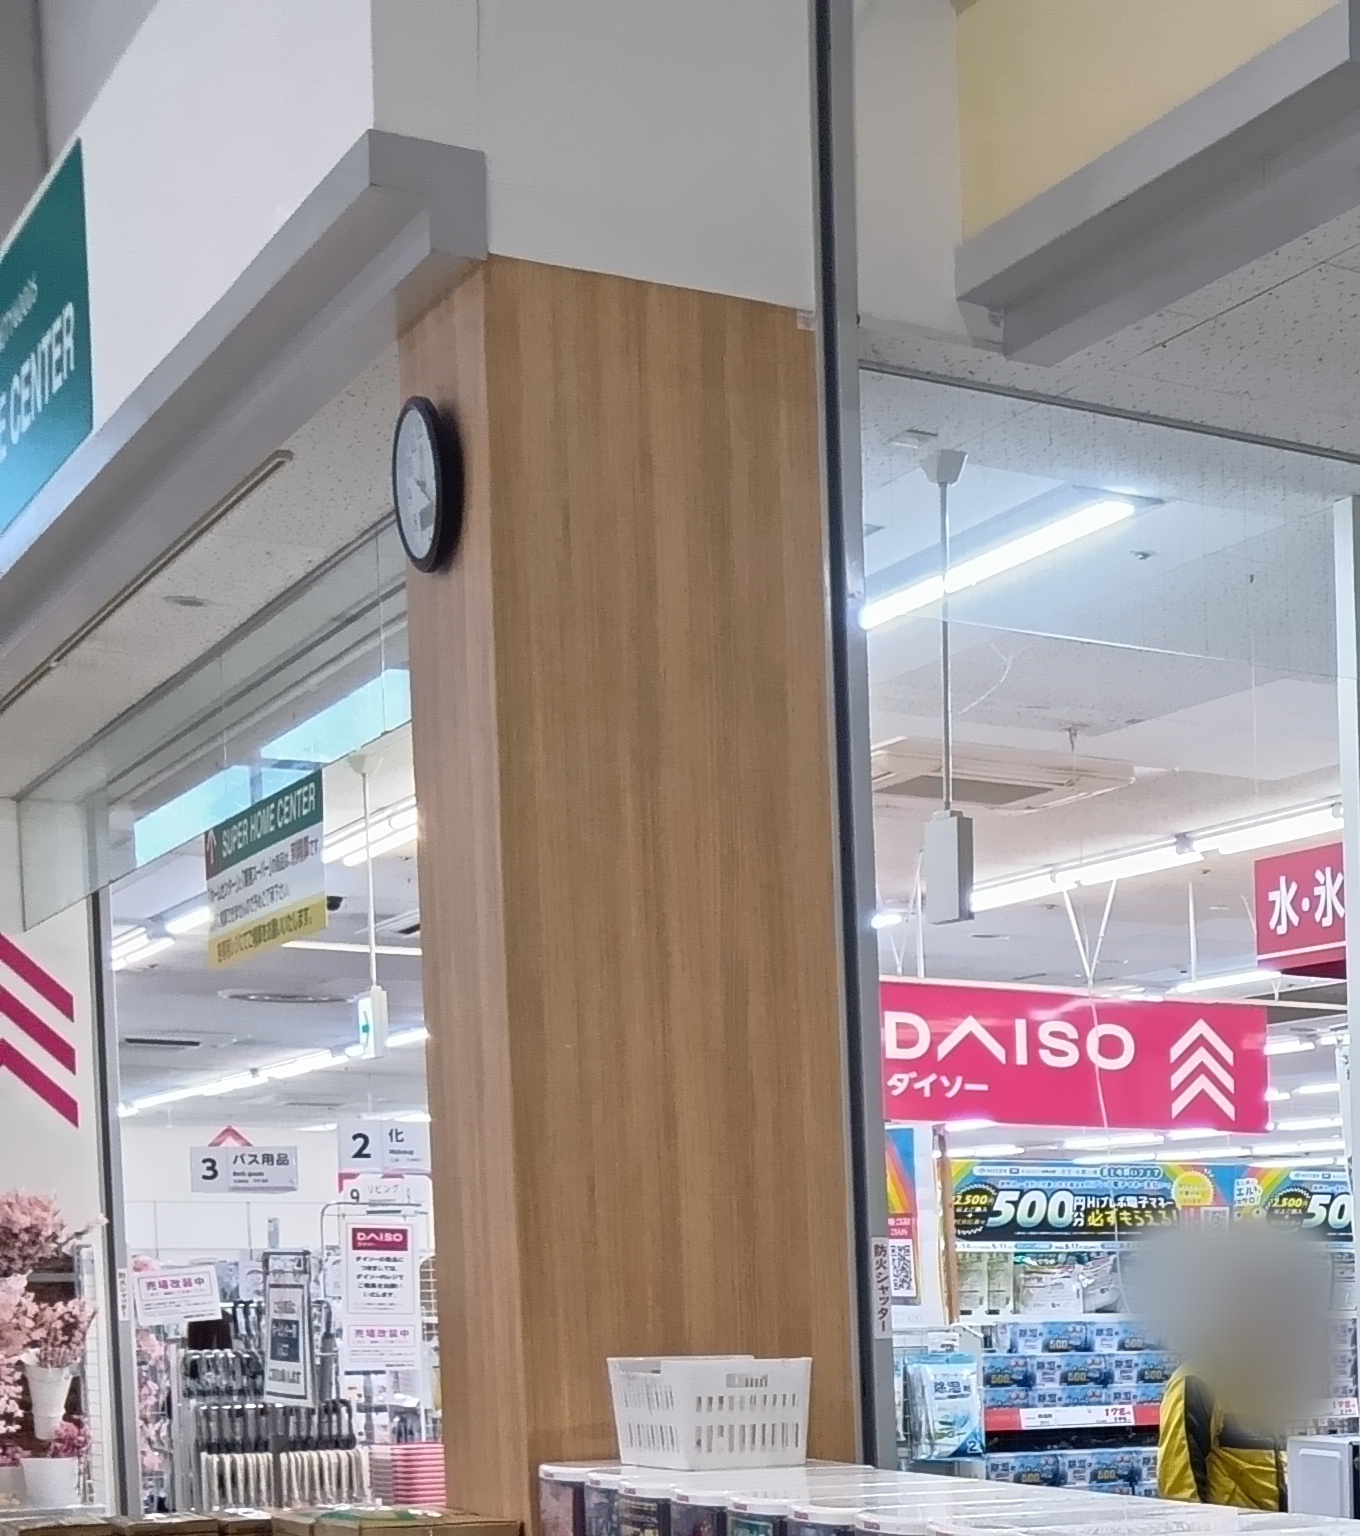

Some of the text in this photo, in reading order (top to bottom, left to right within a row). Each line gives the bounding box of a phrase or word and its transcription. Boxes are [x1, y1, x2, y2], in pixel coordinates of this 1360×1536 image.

[10, 301, 75, 445] CENTER
[222, 781, 316, 859] SUPER HOME CENTER
[885, 1010, 1136, 1072] DAISO
[886, 1071, 989, 1099] ダイソー
[388, 1127, 405, 1143] 化
[351, 1132, 372, 1159] 2
[201, 1157, 219, 1181] 3
[232, 1152, 290, 1167] バス用品
[350, 1188, 360, 1203] 9
[367, 1183, 399, 1195] リビング
[986, 1189, 1074, 1228] 500
[356, 1232, 404, 1242] DAISO
[145, 1277, 205, 1291] 売場改装中
[873, 1242, 890, 1333] 防火シャッター
[355, 1329, 410, 1339] 売場改装中
[968, 1440, 977, 1452] 2
